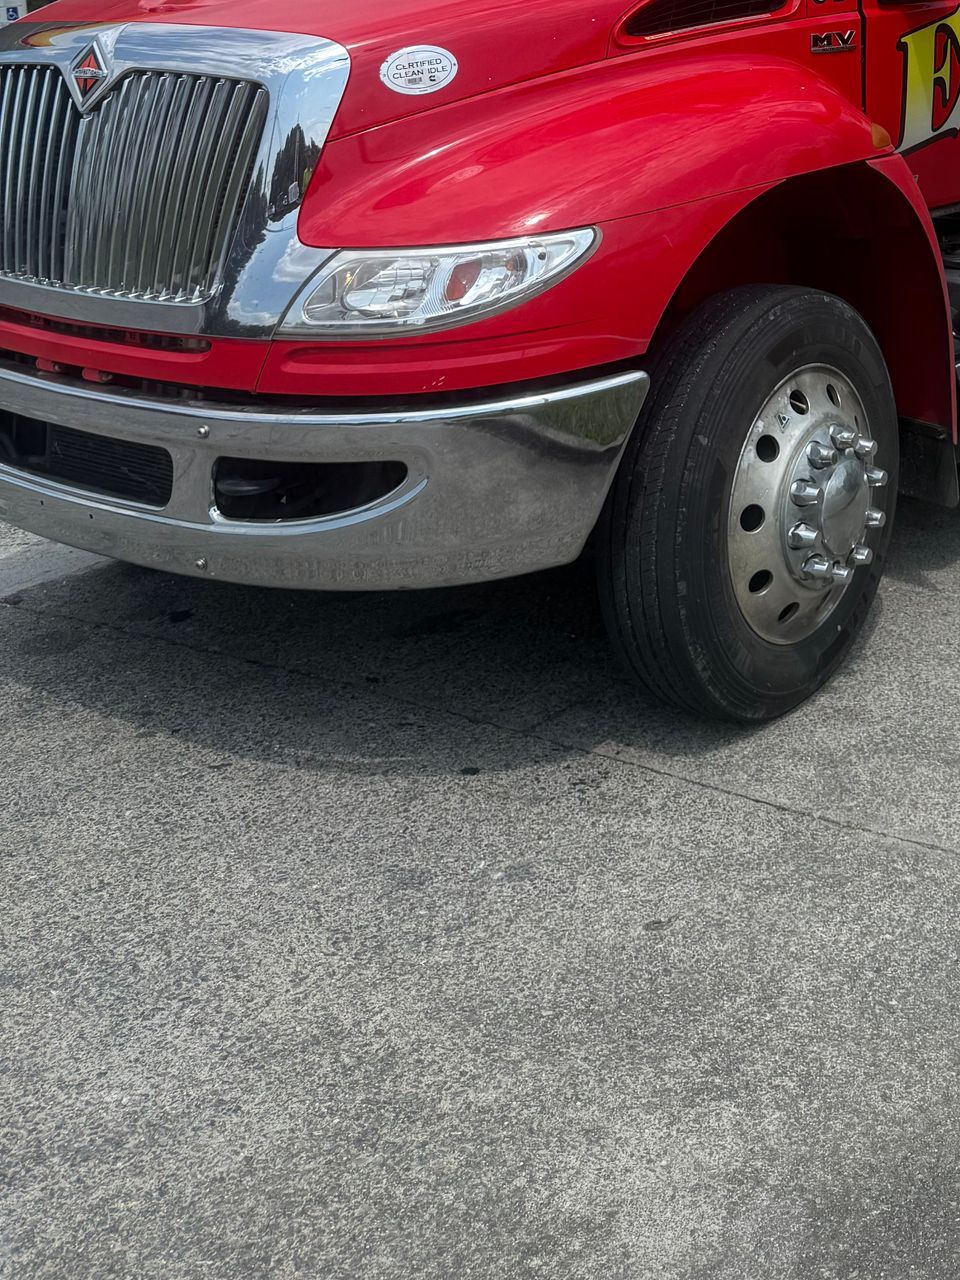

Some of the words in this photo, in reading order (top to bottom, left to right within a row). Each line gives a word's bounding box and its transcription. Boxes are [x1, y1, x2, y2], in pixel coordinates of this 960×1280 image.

[810, 29, 856, 52] MV
[392, 68, 424, 80] CLEAN
[427, 64, 449, 74] IDLE
[395, 58, 442, 71] CERTIFIED
